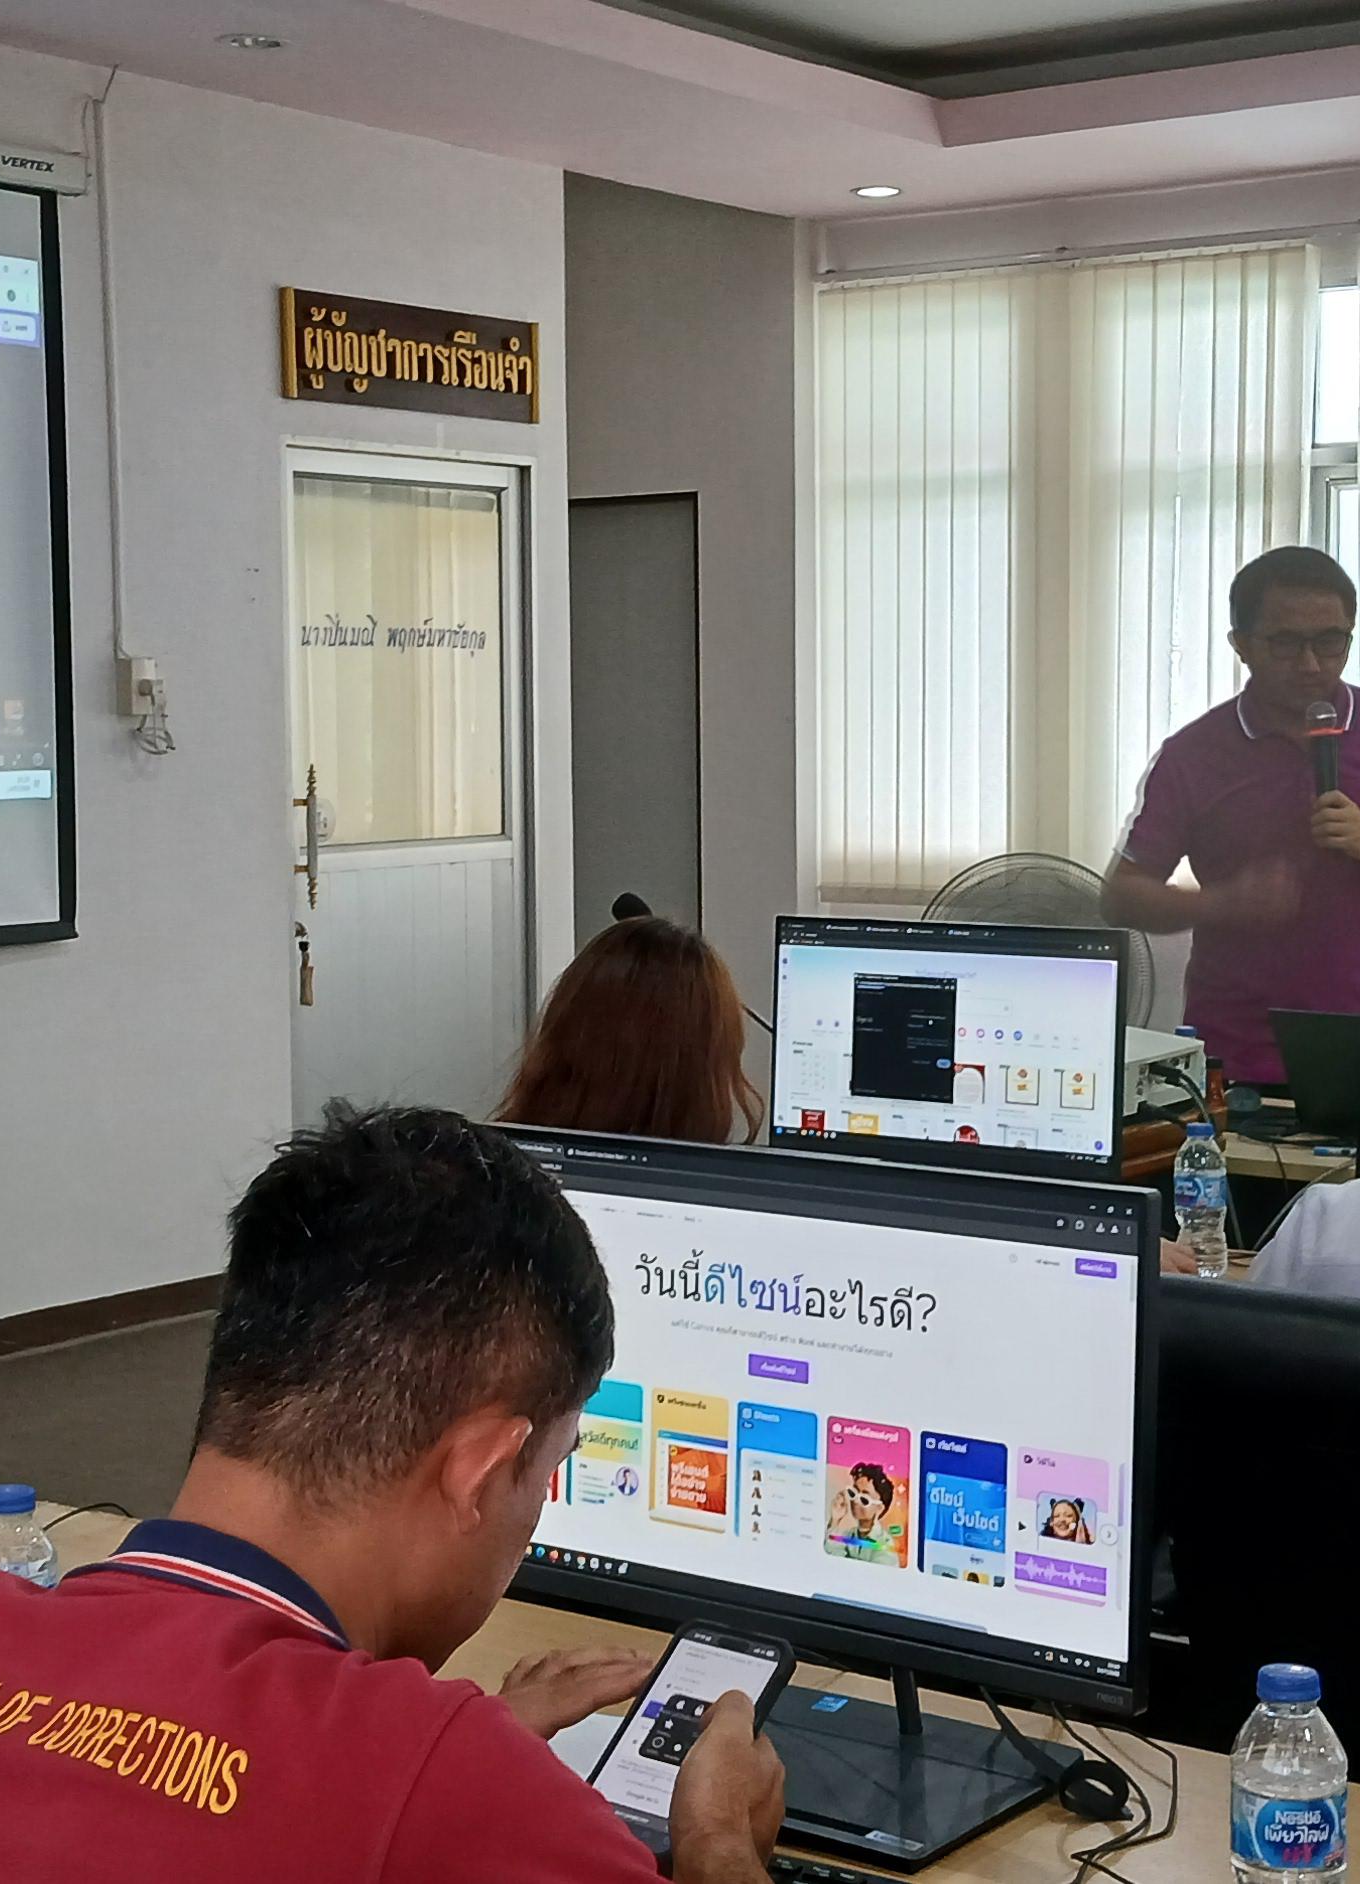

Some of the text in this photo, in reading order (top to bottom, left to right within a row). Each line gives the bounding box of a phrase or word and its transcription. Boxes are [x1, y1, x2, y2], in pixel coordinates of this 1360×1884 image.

[1, 155, 55, 172] VERTEX
[303, 306, 533, 396] ผู้บัญชาการเรือนจำ
[634, 1248, 937, 1334] วันนี้ดีไซน์อะไรดี?
[27, 1699, 249, 1815] CORRECTIONS
